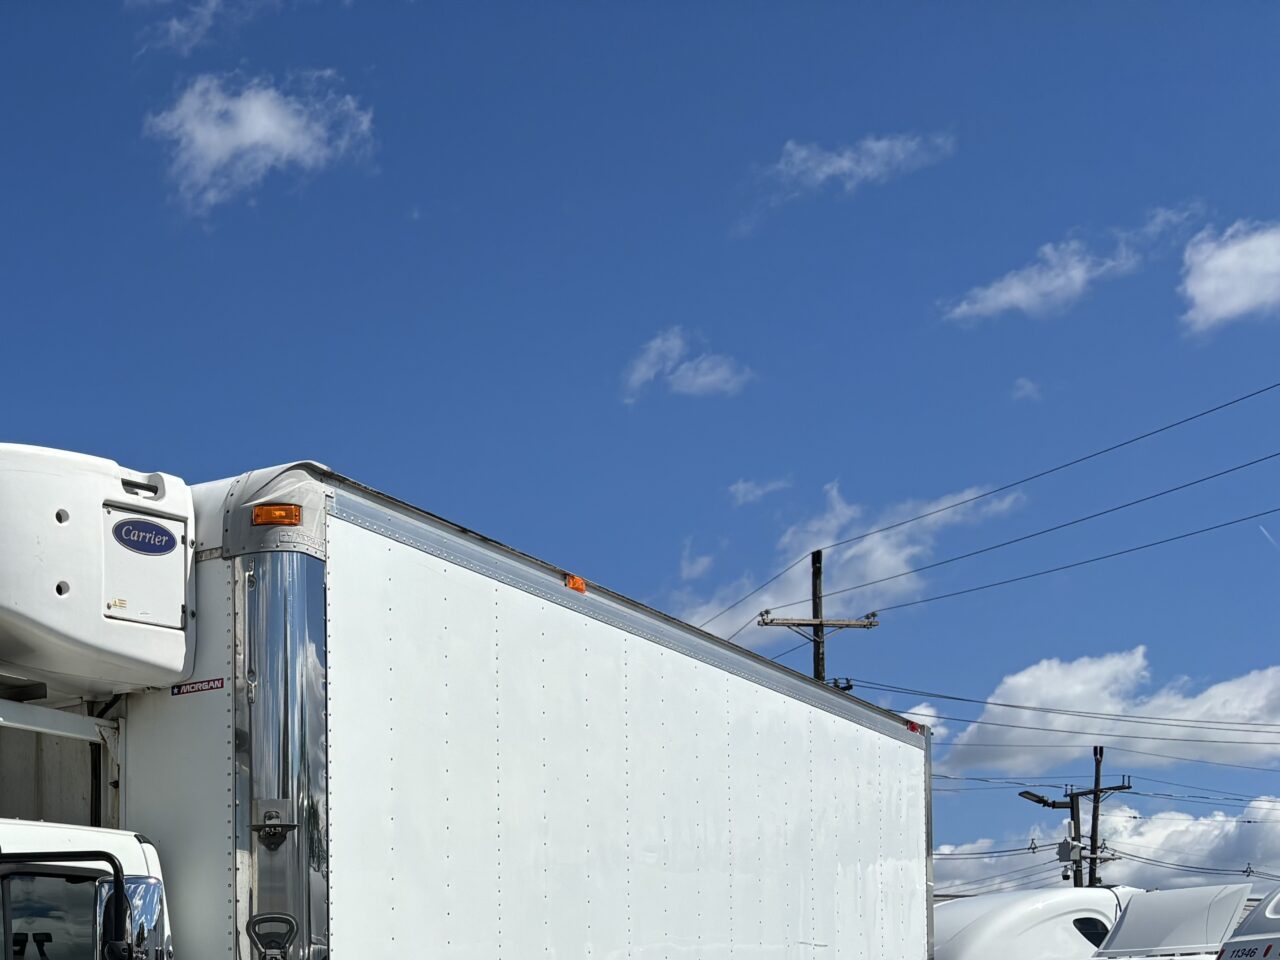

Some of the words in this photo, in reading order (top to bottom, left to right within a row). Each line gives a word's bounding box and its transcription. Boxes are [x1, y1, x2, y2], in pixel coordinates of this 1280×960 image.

[121, 525, 169, 546] Carrier
[180, 679, 223, 693] MORGAN
[1230, 947, 1258, 959] 11346
